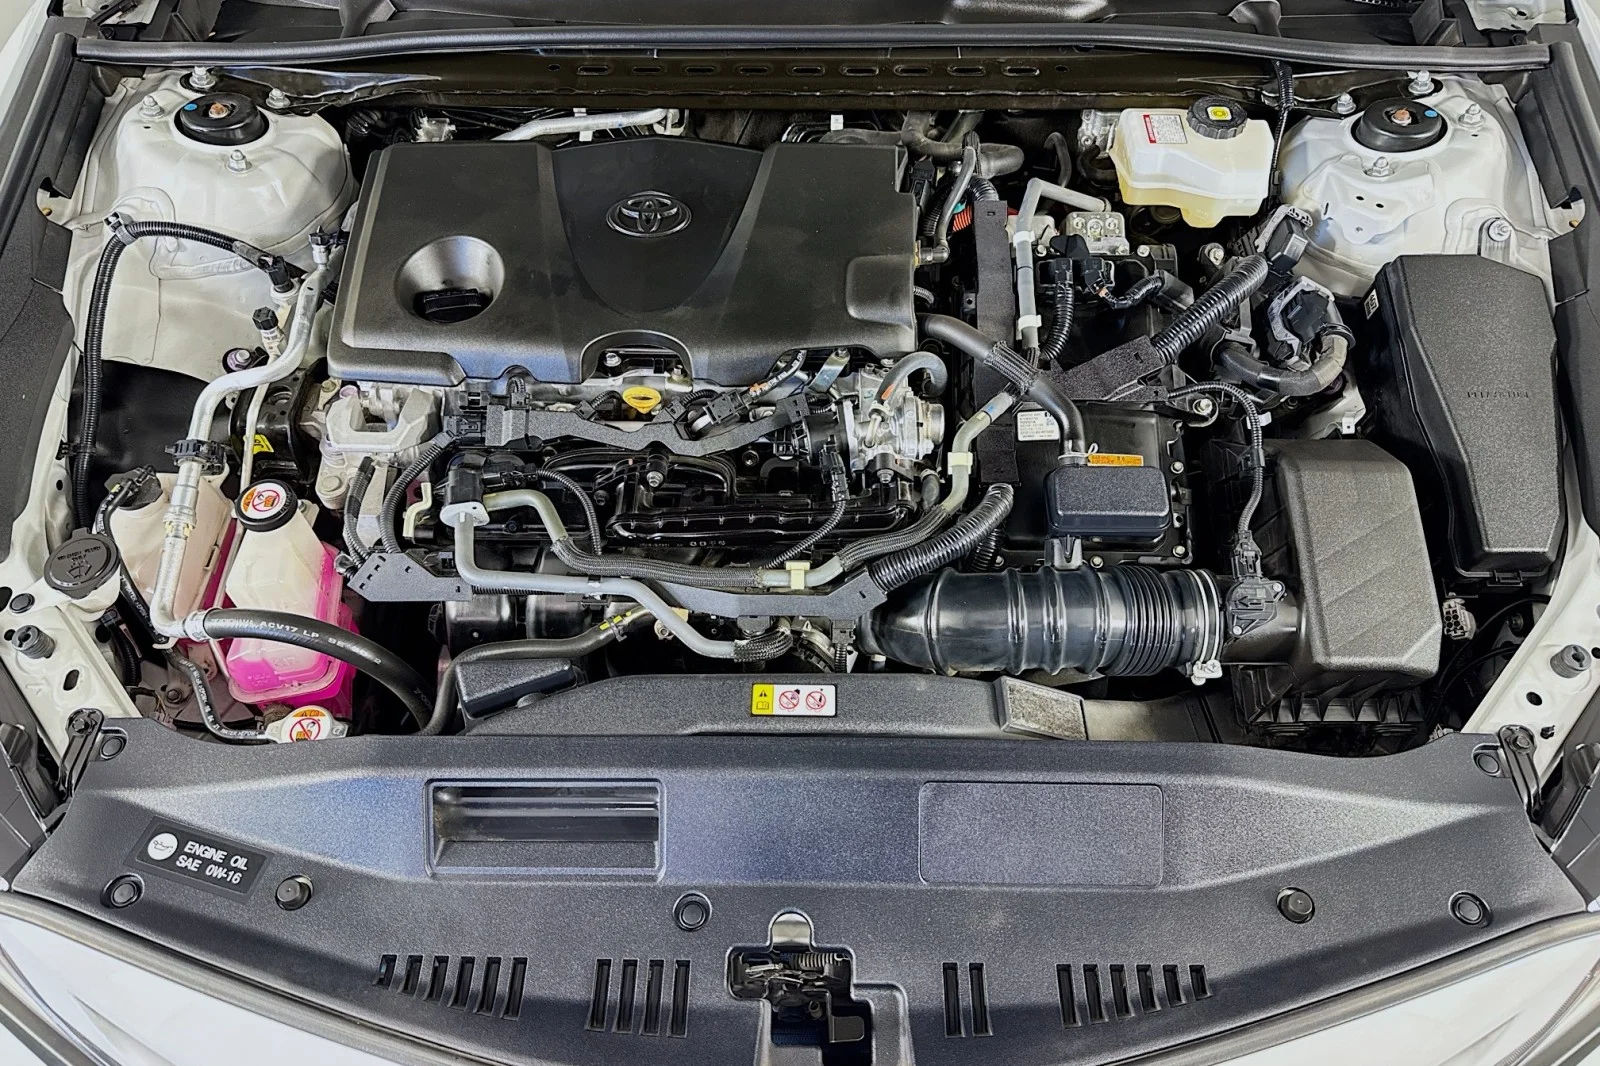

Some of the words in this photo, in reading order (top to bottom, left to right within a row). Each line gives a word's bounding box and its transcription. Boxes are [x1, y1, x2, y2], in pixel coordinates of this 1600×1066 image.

[260, 621, 299, 632] ACV17
[303, 629, 320, 638] LP
[175, 855, 202, 872] SAE
[205, 864, 242, 884] 0W-16
[184, 841, 227, 863] ENGINE
[230, 855, 248, 870] OIL
